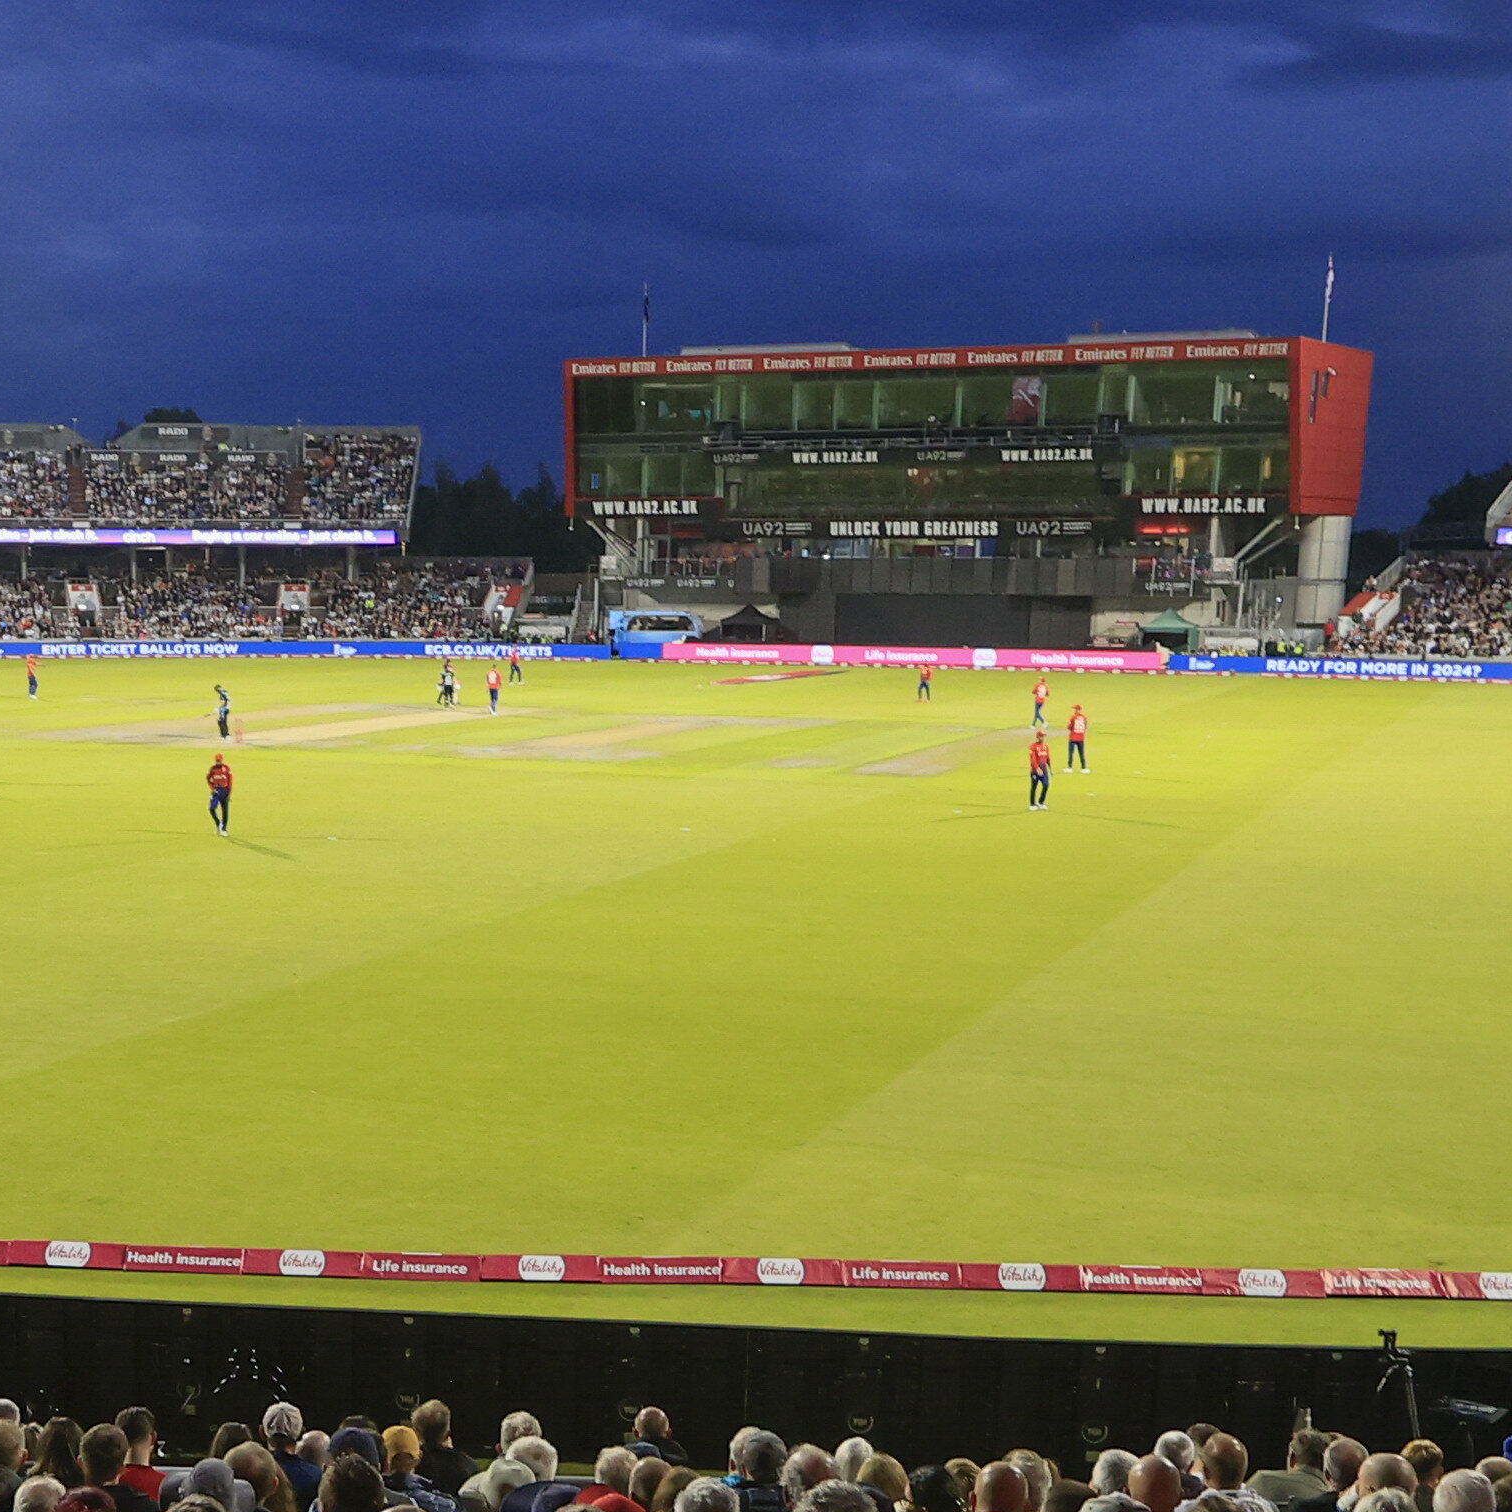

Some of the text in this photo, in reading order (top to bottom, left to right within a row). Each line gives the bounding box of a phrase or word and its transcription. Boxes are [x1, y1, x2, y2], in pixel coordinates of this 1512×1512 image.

[967, 352, 1018, 364] Emirates
[1075, 348, 1127, 360] Emirates
[1186, 344, 1239, 358] Emirates
[665, 360, 712, 372] Emirates
[763, 358, 811, 370] Emirates
[863, 354, 912, 366] Emirates
[572, 362, 616, 374] Emirates
[792, 451, 879, 464] WWW.UA92.AC.UK
[1001, 448, 1093, 462] WWW.UA92.AC.UK
[592, 500, 699, 516] WWW.UA92.AC.UK
[1141, 498, 1266, 514] WWW.UA92.AC.UK
[742, 522, 785, 536] UA92
[829, 520, 999, 536] UNLOCK YOUR GREATNESS
[1016, 521, 1061, 536] UA92
[42, 644, 238, 656] ENTER TICKET BALLOTS NOW
[696, 647, 779, 659] Health insurance
[864, 650, 938, 662] Life insurance
[1030, 653, 1124, 666] Health insurance
[1266, 659, 1482, 677] READY FOR MORE IN 2024?
[47, 1243, 89, 1263] Vitality
[127, 1251, 242, 1267] Health insurance
[281, 1251, 324, 1272] Vitality
[373, 1259, 468, 1275] Life insurance
[520, 1256, 563, 1277] Vitality
[603, 1263, 722, 1277] Health insurance
[759, 1259, 804, 1279] Vitality
[852, 1267, 949, 1282] Life insurance
[1000, 1264, 1044, 1285] Vitality
[1241, 1272, 1285, 1292] Vitality
[1334, 1276, 1430, 1290] Life insurance
